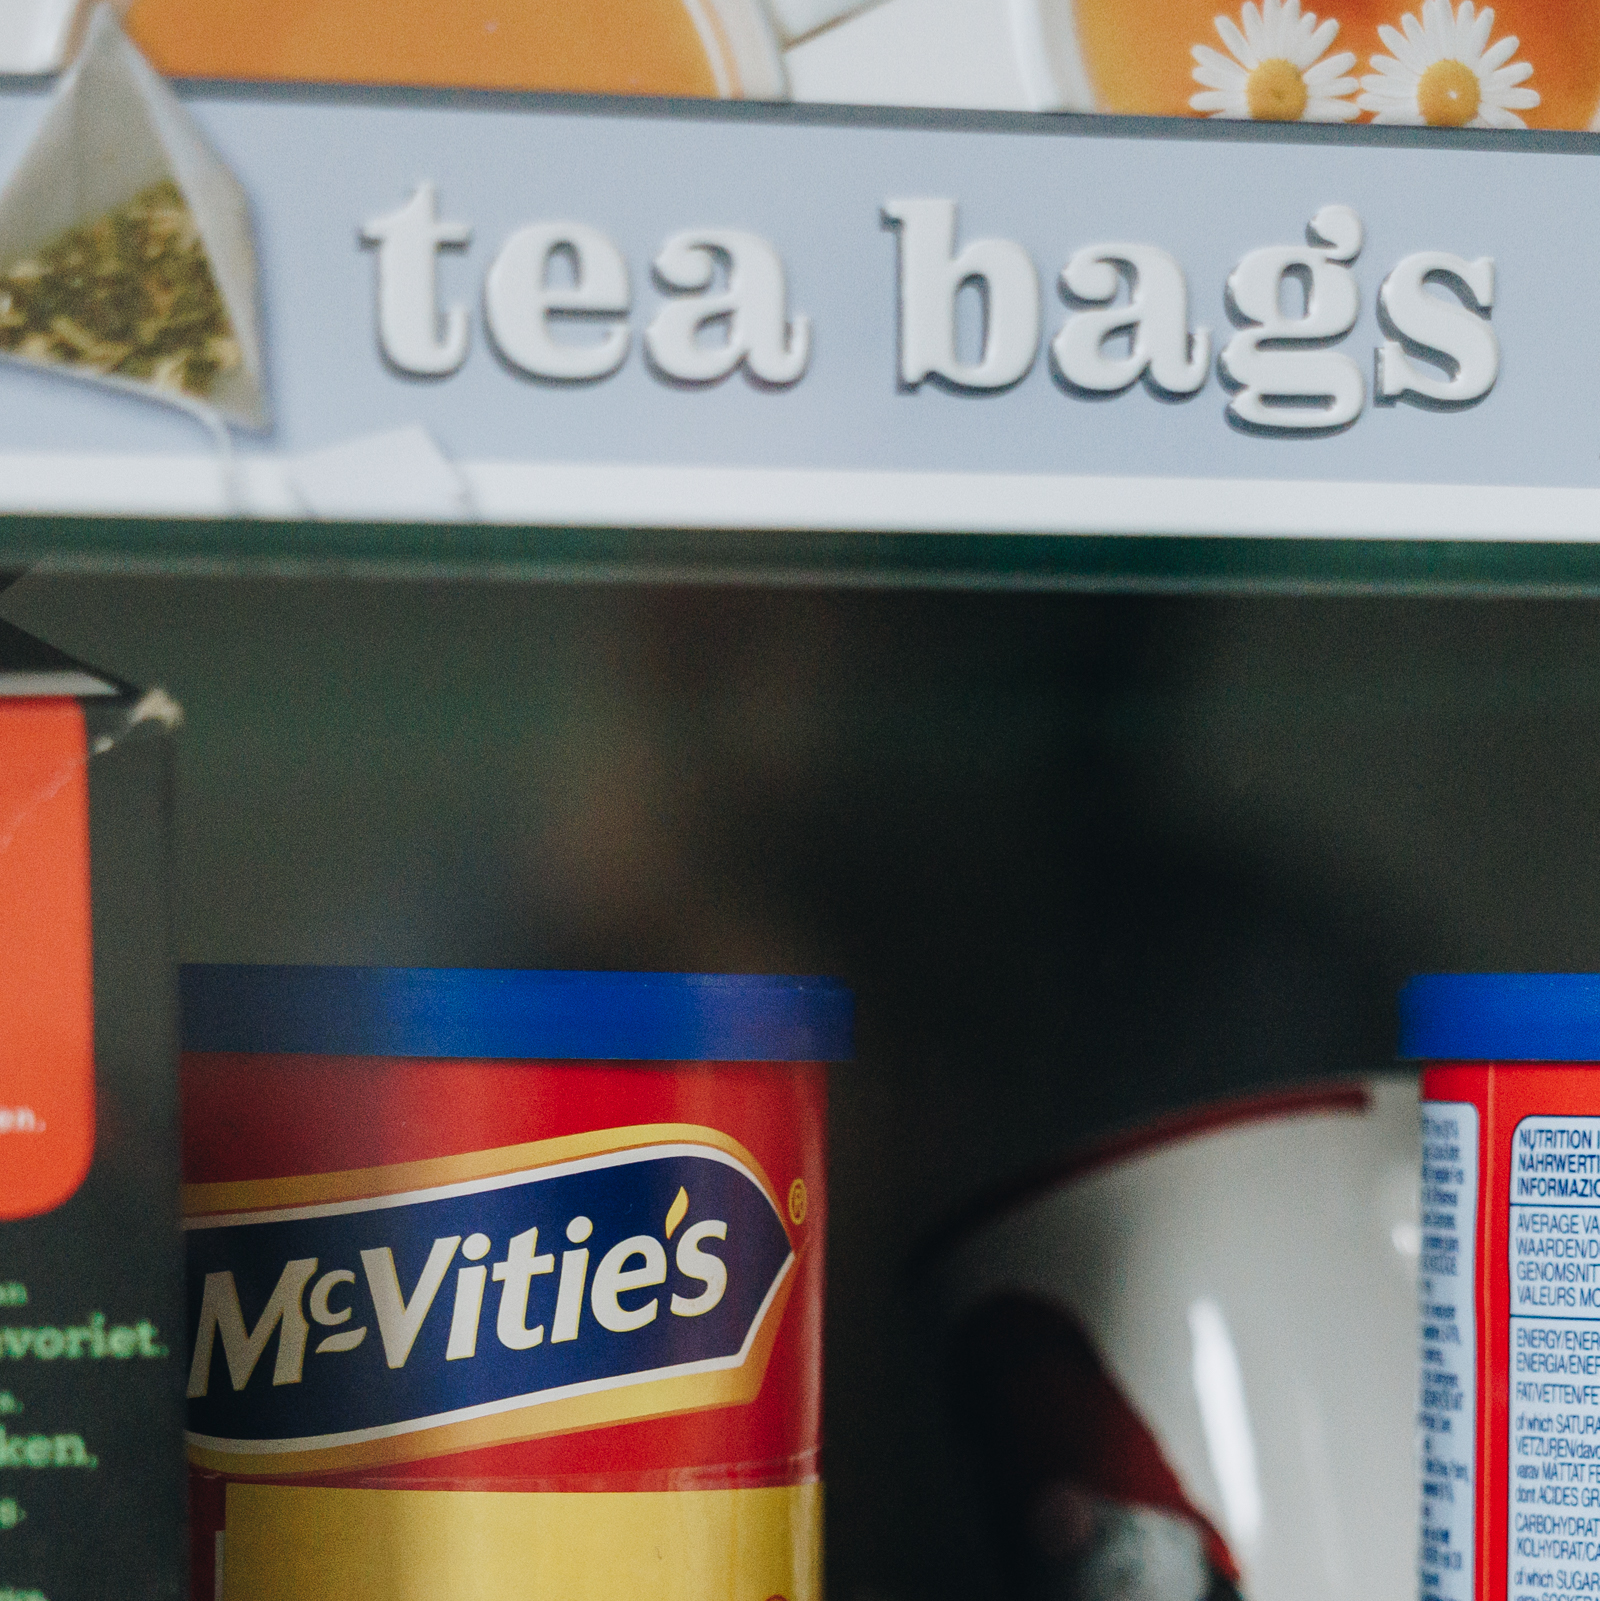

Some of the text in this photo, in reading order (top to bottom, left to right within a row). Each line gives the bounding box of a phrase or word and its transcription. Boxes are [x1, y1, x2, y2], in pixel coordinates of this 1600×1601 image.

[358, 182, 1499, 438] tea bags
[1519, 1129, 1592, 1150] NUTRITION
[1515, 1213, 1580, 1235] AVERAGE
[186, 1186, 728, 1400] McVitie's
[1517, 1286, 1576, 1308] VALEURS
